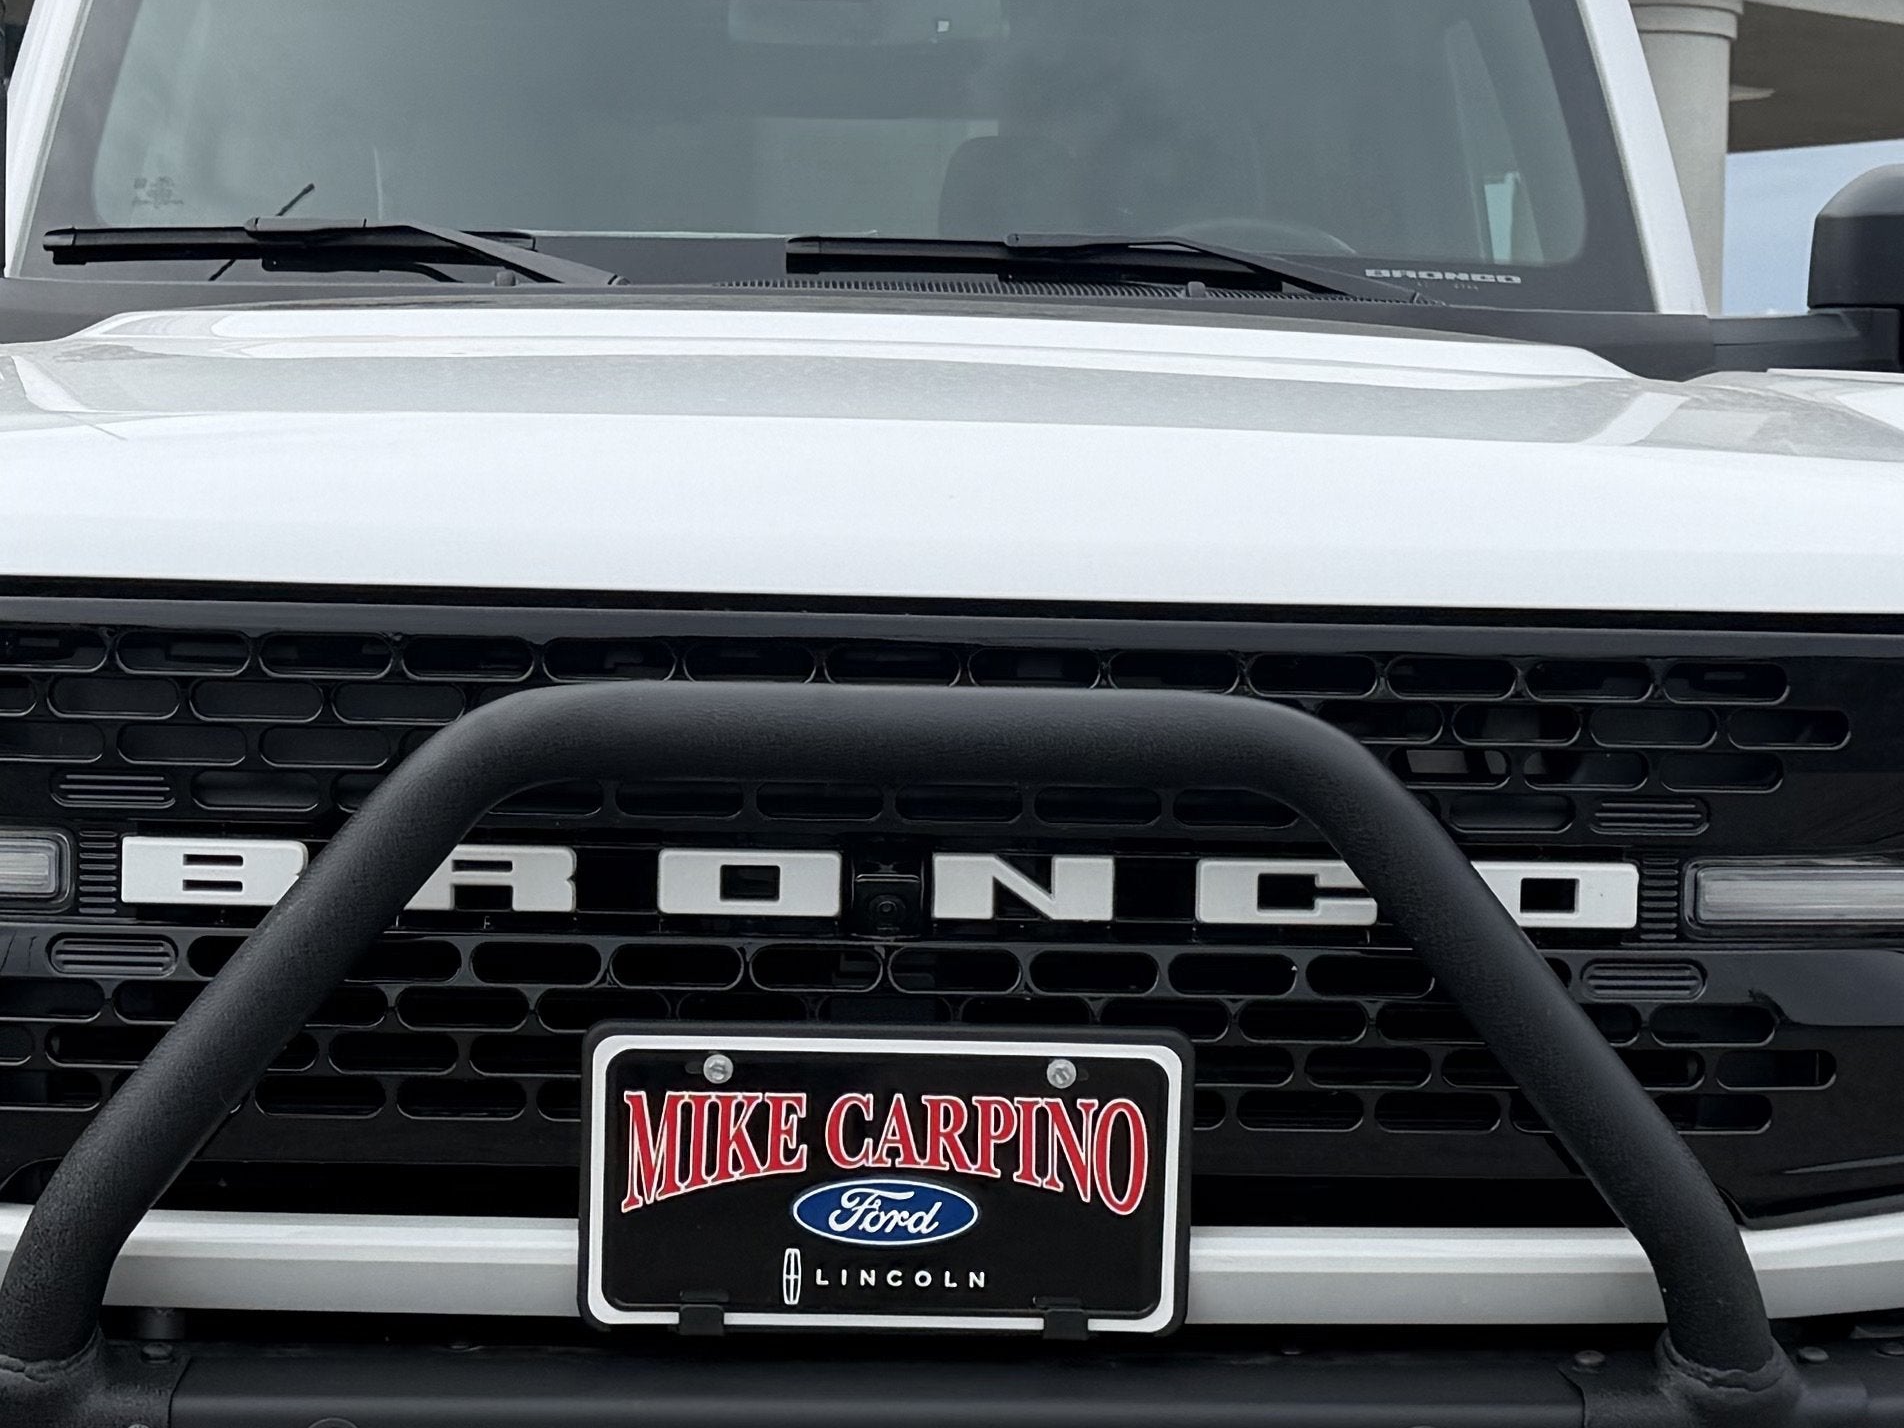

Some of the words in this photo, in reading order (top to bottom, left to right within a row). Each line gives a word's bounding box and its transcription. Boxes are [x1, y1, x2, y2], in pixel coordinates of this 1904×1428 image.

[120, 835, 1640, 929] BRONCO
[621, 1091, 807, 1214] MIKE
[825, 1091, 1149, 1216] CARPINO
[828, 1187, 943, 1234] Ford
[815, 1267, 987, 1289] LINCOLN
